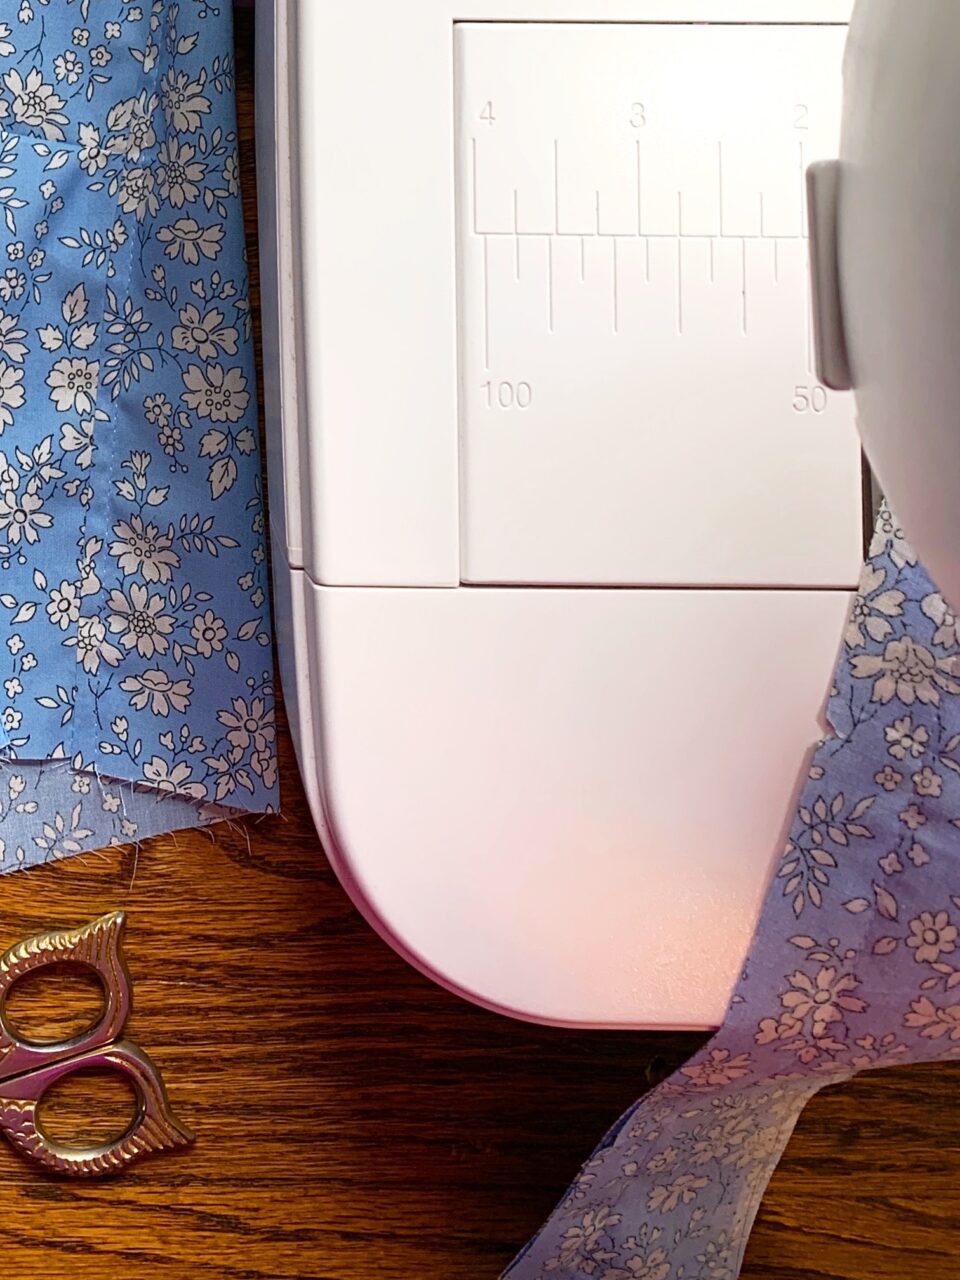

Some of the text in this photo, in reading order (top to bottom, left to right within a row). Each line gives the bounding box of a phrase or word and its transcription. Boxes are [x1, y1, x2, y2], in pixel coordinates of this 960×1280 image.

[478, 100, 496, 126] 4
[629, 101, 646, 129] 3
[792, 103, 809, 130] 2
[479, 380, 533, 410] 100
[791, 385, 828, 413] 50
